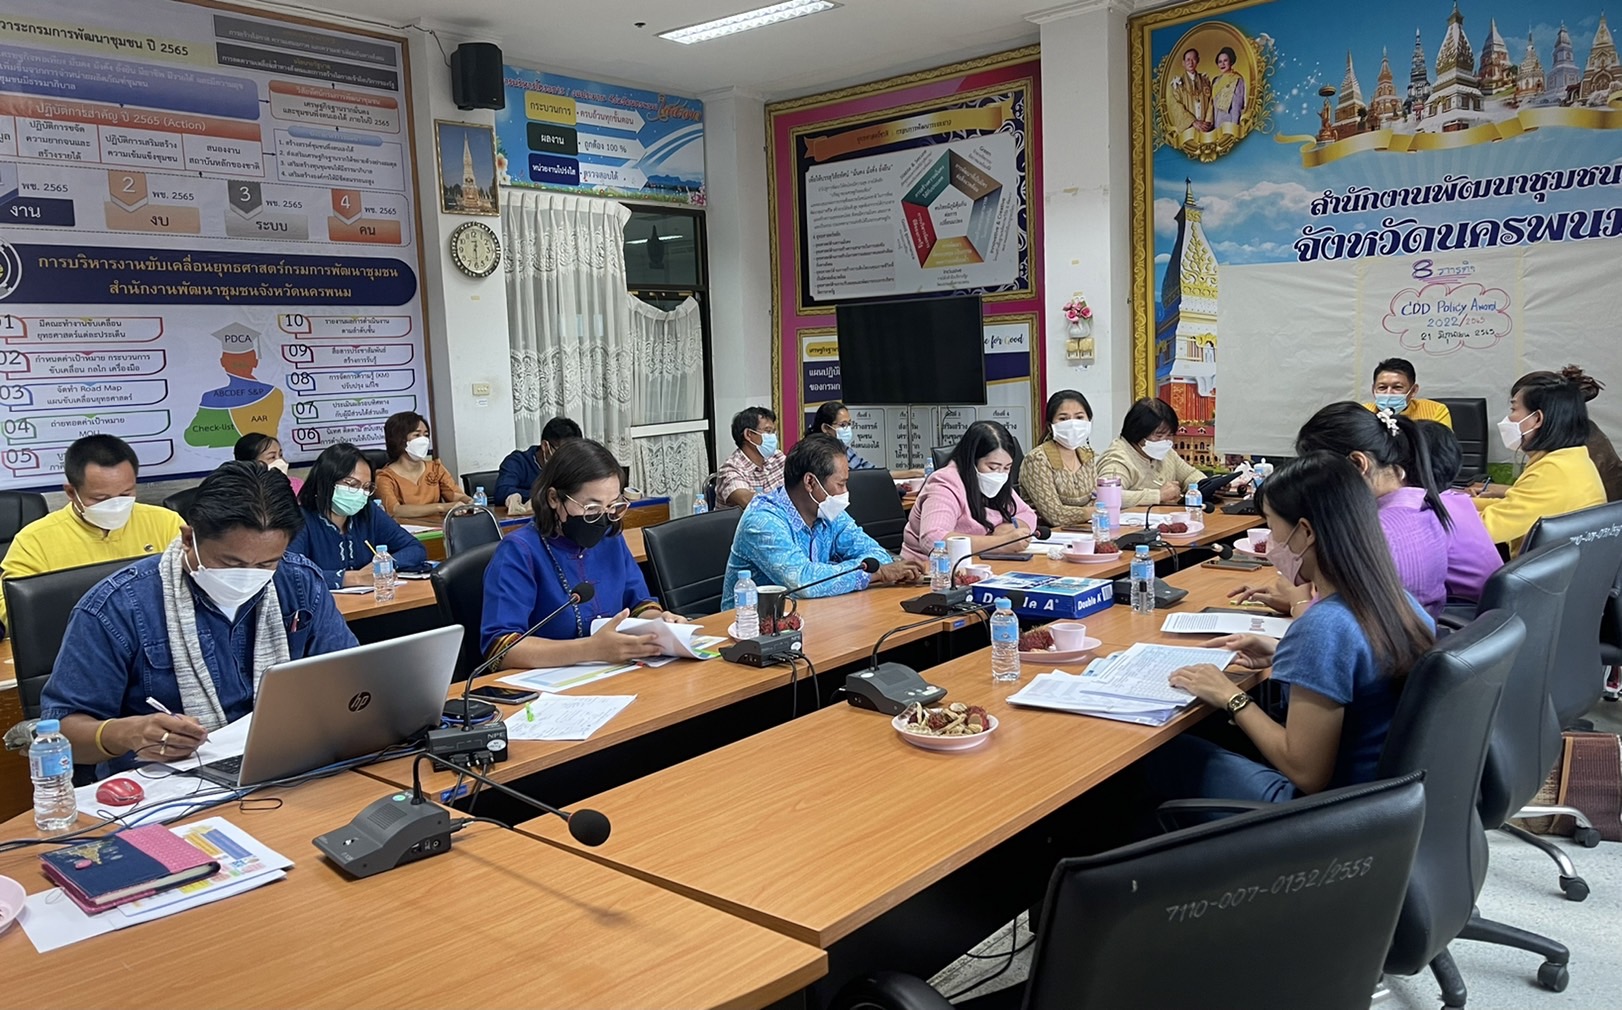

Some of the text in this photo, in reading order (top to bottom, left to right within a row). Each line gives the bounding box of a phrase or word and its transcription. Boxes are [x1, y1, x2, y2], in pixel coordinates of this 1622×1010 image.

[146, 38, 156, 51] ปี
[160, 43, 188, 56] 2565
[530, 101, 571, 117] กระบวนการ
[122, 110, 131, 123] ปี
[133, 114, 160, 126] 2565
[163, 119, 206, 131] (Action)
[374, 119, 390, 127] 2565
[580, 107, 634, 126] ครบถ้วนทุกขั้นตอน
[540, 133, 565, 145] ผลงาน
[584, 140, 627, 153] ถูกต้อง 100 %
[43, 184, 69, 192] 2565
[122, 176, 136, 193] 2
[1310, 163, 1622, 216] สำนักงานพัฒนาชุมชน
[172, 192, 195, 201] 2565
[239, 186, 251, 202] 3
[283, 200, 303, 209] 2565
[340, 195, 351, 209] 4
[9, 203, 41, 219] งาน
[379, 207, 397, 215] 2565
[150, 214, 170, 227] งบ
[255, 220, 288, 232] ระบบ
[359, 225, 376, 236] คน
[38, 252, 399, 281] การบริหารงานขับเคลื่อนยุทธศาสตร์กรมการพัฒนาชุมชน
[1411, 258, 1434, 279] 8
[109, 280, 352, 300] สำนักงานพัฒนาชุมชนจังหวัดนครพนม
[1400, 297, 1497, 316] CDD Policy Award
[285, 314, 304, 327] 10
[224, 334, 253, 344] PDCA
[1420, 332, 1432, 341] 21
[1474, 328, 1496, 337] 2565
[288, 344, 308, 357] 09
[0, 349, 22, 366] 02
[107, 354, 151, 362] กระบวนการ
[290, 372, 310, 385] 08
[0, 384, 25, 401] 03
[80, 385, 102, 393] Road
[104, 385, 123, 394] Map
[213, 388, 265, 398] ABCDEF S&P
[808, 383, 841, 392] ของกรมก
[295, 401, 315, 415] 07
[250, 414, 268, 423] AAR
[4, 418, 30, 434] 04
[192, 423, 235, 433] Check-list
[296, 428, 316, 441] 06
[6, 448, 33, 464] 05
[1044, 598, 1055, 611] A
[1077, 596, 1097, 611] Double
